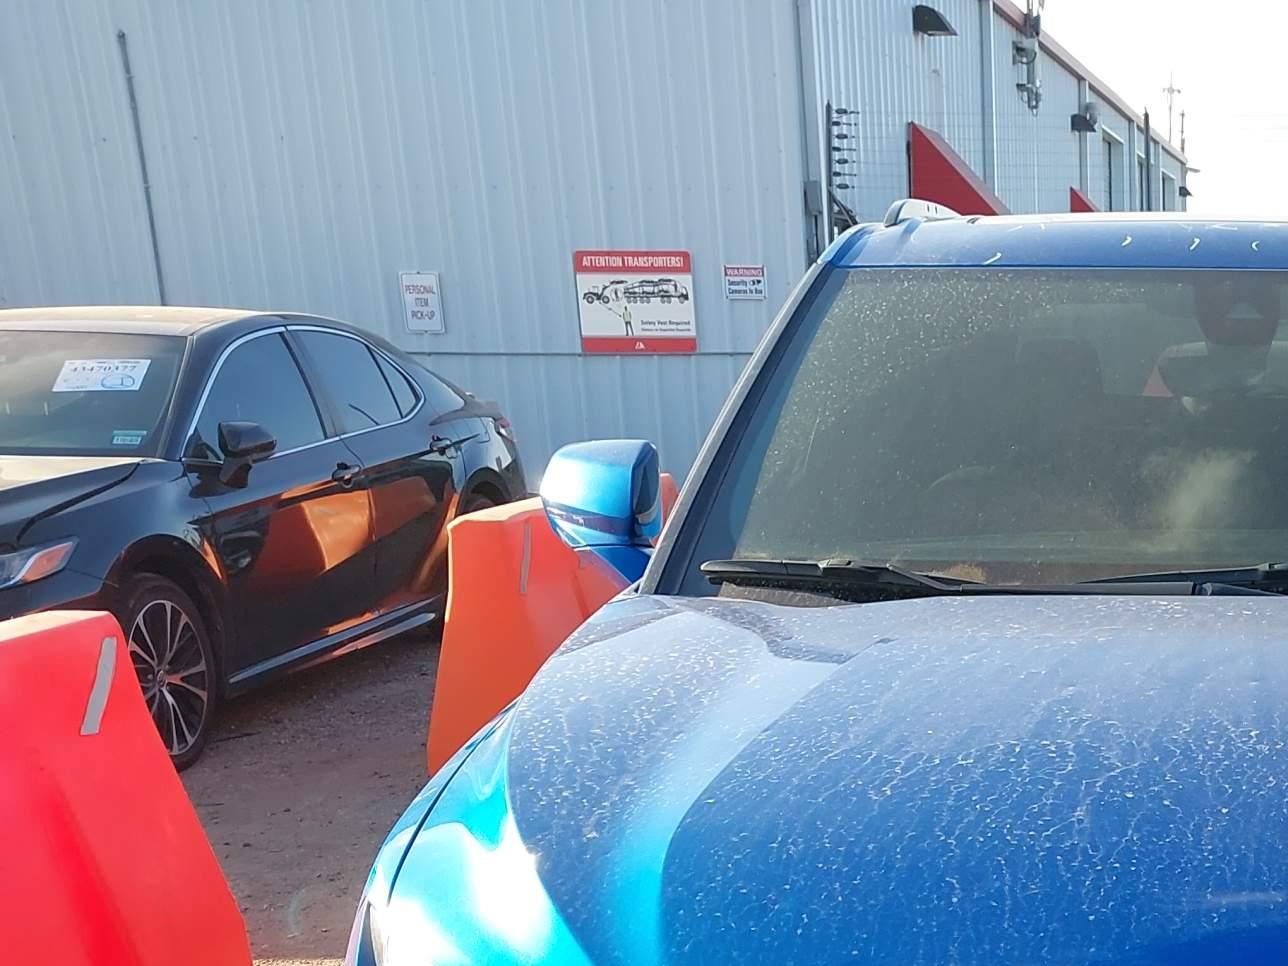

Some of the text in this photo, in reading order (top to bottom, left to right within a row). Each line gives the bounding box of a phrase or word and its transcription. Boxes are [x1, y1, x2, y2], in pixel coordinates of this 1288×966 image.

[582, 256, 684, 267] ATTENTION TRANSPORTERS!
[405, 285, 436, 295] PERSONAL
[414, 297, 429, 307] ITEM
[410, 310, 436, 320] PICK-UP
